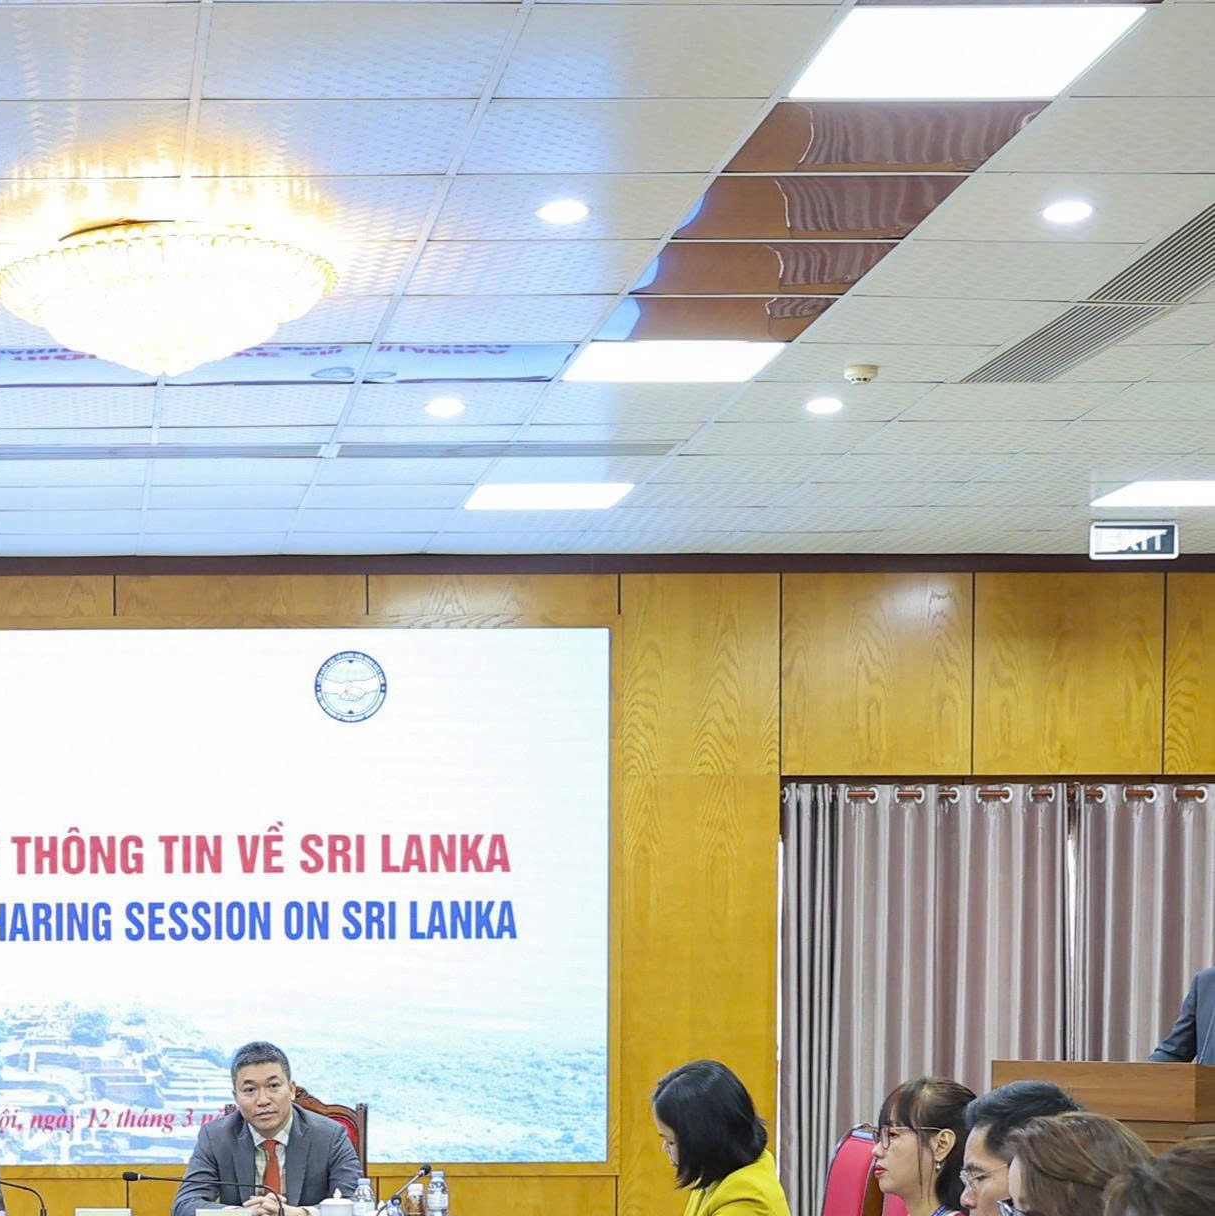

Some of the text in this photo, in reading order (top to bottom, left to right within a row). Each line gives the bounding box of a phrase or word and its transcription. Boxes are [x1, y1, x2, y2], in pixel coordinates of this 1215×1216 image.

[11, 827, 145, 876] THÔNG
[158, 834, 223, 875] TIN
[237, 820, 285, 874] VỀ
[300, 833, 366, 875] SRI
[381, 833, 511, 874] LANKA
[125, 901, 272, 942] SESSION
[284, 900, 330, 941] ON
[342, 900, 397, 941] SRI
[409, 899, 518, 940] LANKA
[30, 1107, 79, 1134] ngày
[87, 1107, 111, 1129] 12
[115, 1107, 176, 1133] tháng
[181, 1107, 194, 1128] 3
